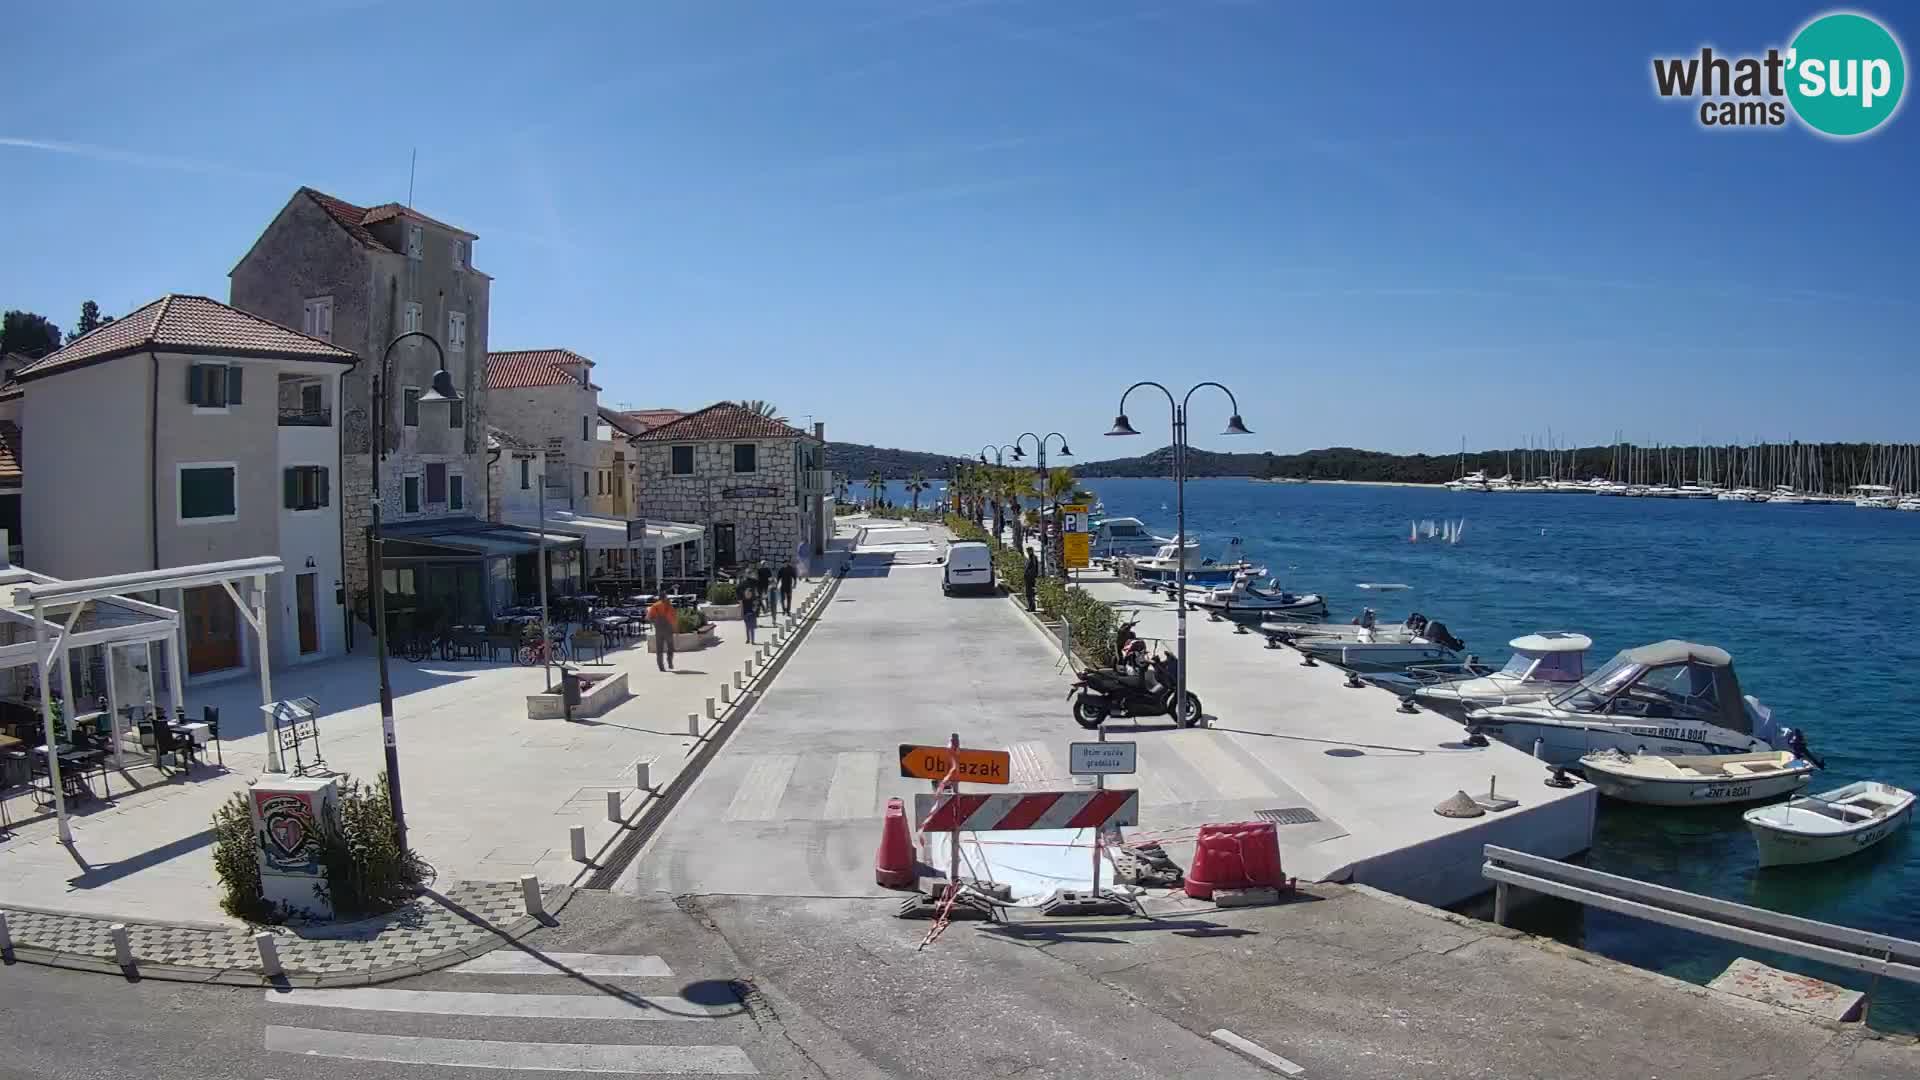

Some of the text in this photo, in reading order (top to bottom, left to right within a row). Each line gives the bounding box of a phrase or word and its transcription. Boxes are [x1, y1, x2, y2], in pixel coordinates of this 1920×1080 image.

[1065, 514, 1076, 531] P
[1658, 727, 1680, 739] RENT
[1680, 728, 1686, 740] A
[1687, 729, 1708, 742] BOAT
[924, 756, 1000, 777] Obazak
